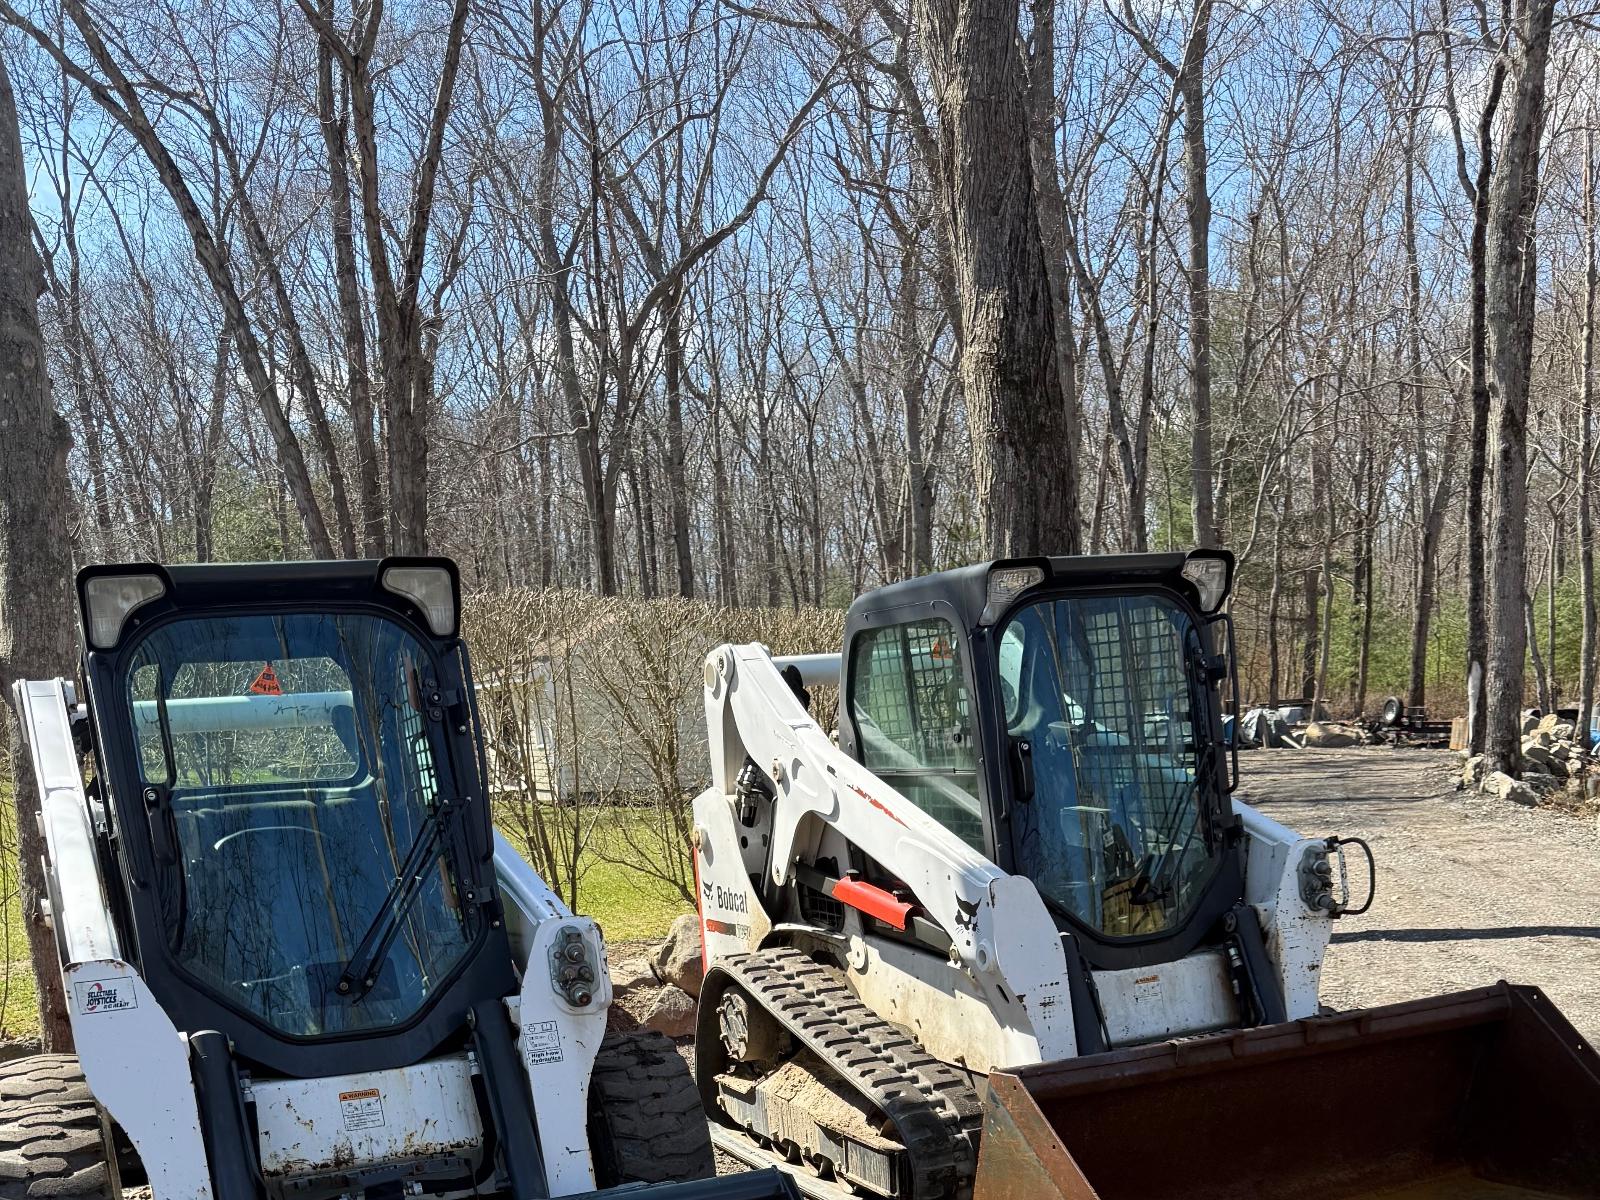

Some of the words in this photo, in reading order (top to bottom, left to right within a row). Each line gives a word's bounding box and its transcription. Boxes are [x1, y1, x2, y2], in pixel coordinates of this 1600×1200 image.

[716, 885, 749, 914] Bobcat
[87, 988, 117, 999] SELECTABLE
[86, 995, 117, 1007] JOYSTICKS
[348, 1090, 377, 1099] WARNING
